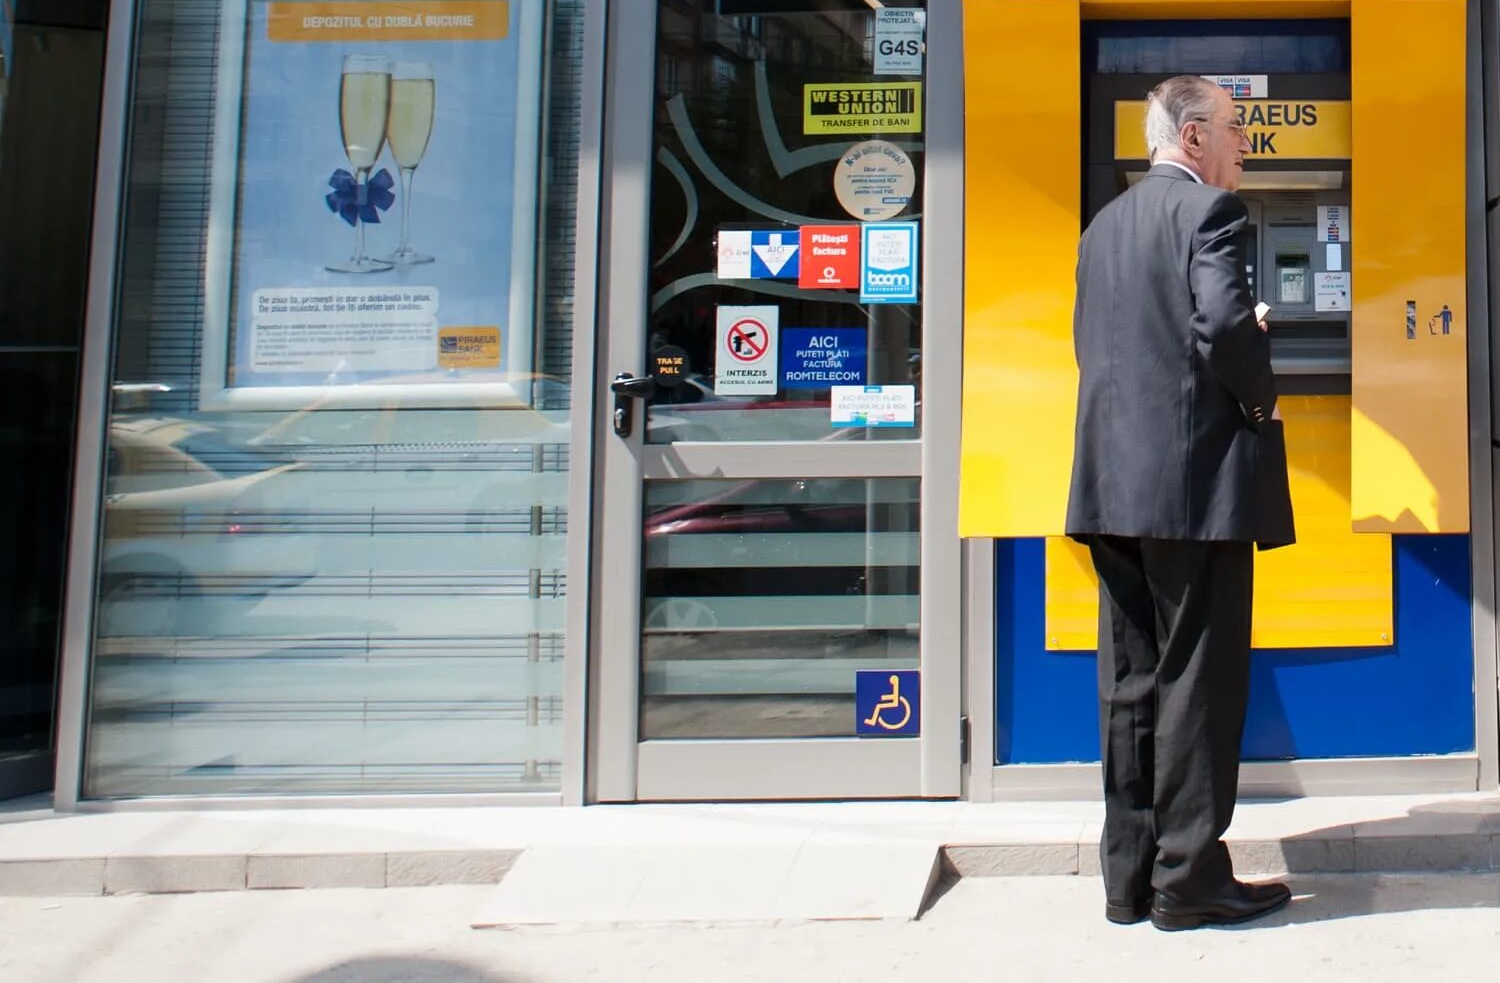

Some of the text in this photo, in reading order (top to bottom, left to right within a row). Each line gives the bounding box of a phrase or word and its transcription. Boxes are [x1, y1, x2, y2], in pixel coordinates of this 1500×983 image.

[303, 16, 363, 28] DEPOZITUL
[367, 16, 382, 27] CU
[425, 14, 474, 27] BUCURIE
[879, 40, 919, 56] G4S
[812, 90, 897, 103] WESTERN
[838, 103, 897, 114] UNION
[1234, 104, 1317, 126] RAEUS
[888, 118, 910, 126] BANI
[813, 247, 846, 256] factura
[868, 271, 910, 285] boom
[458, 335, 497, 344] PIRAEUS
[808, 336, 838, 349] AICI
[796, 350, 824, 359] PUTETI
[803, 360, 842, 369] FACTURA
[786, 372, 860, 381] ROMTELECOM
